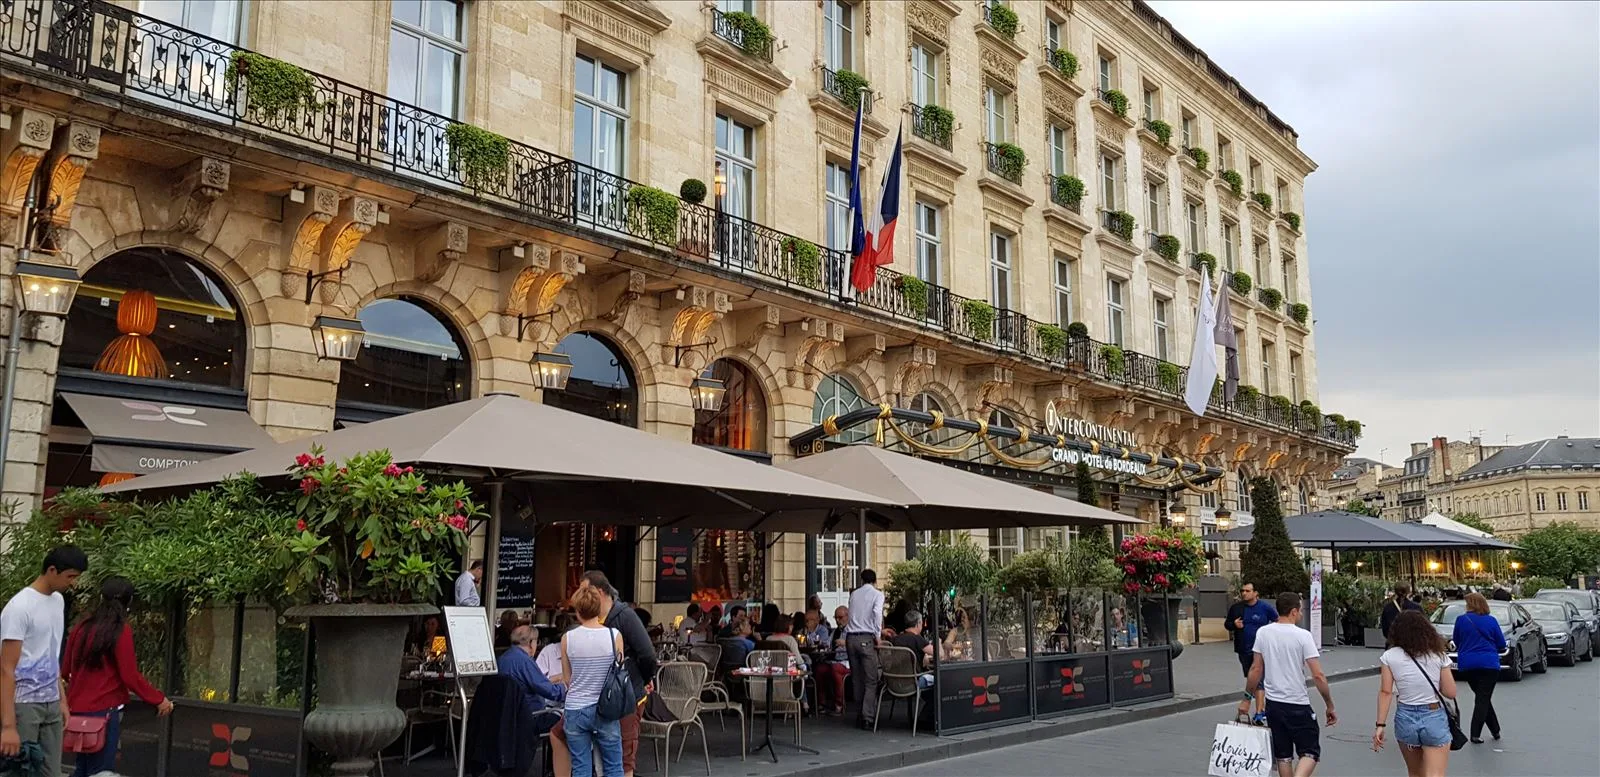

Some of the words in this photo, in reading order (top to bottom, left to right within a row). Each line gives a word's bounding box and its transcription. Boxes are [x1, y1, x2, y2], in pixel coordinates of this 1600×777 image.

[1052, 448, 1078, 464] GRAND
[1081, 453, 1104, 469] HOTEL
[1104, 455, 1113, 470] de
[1113, 458, 1147, 475] BORDEAUX
